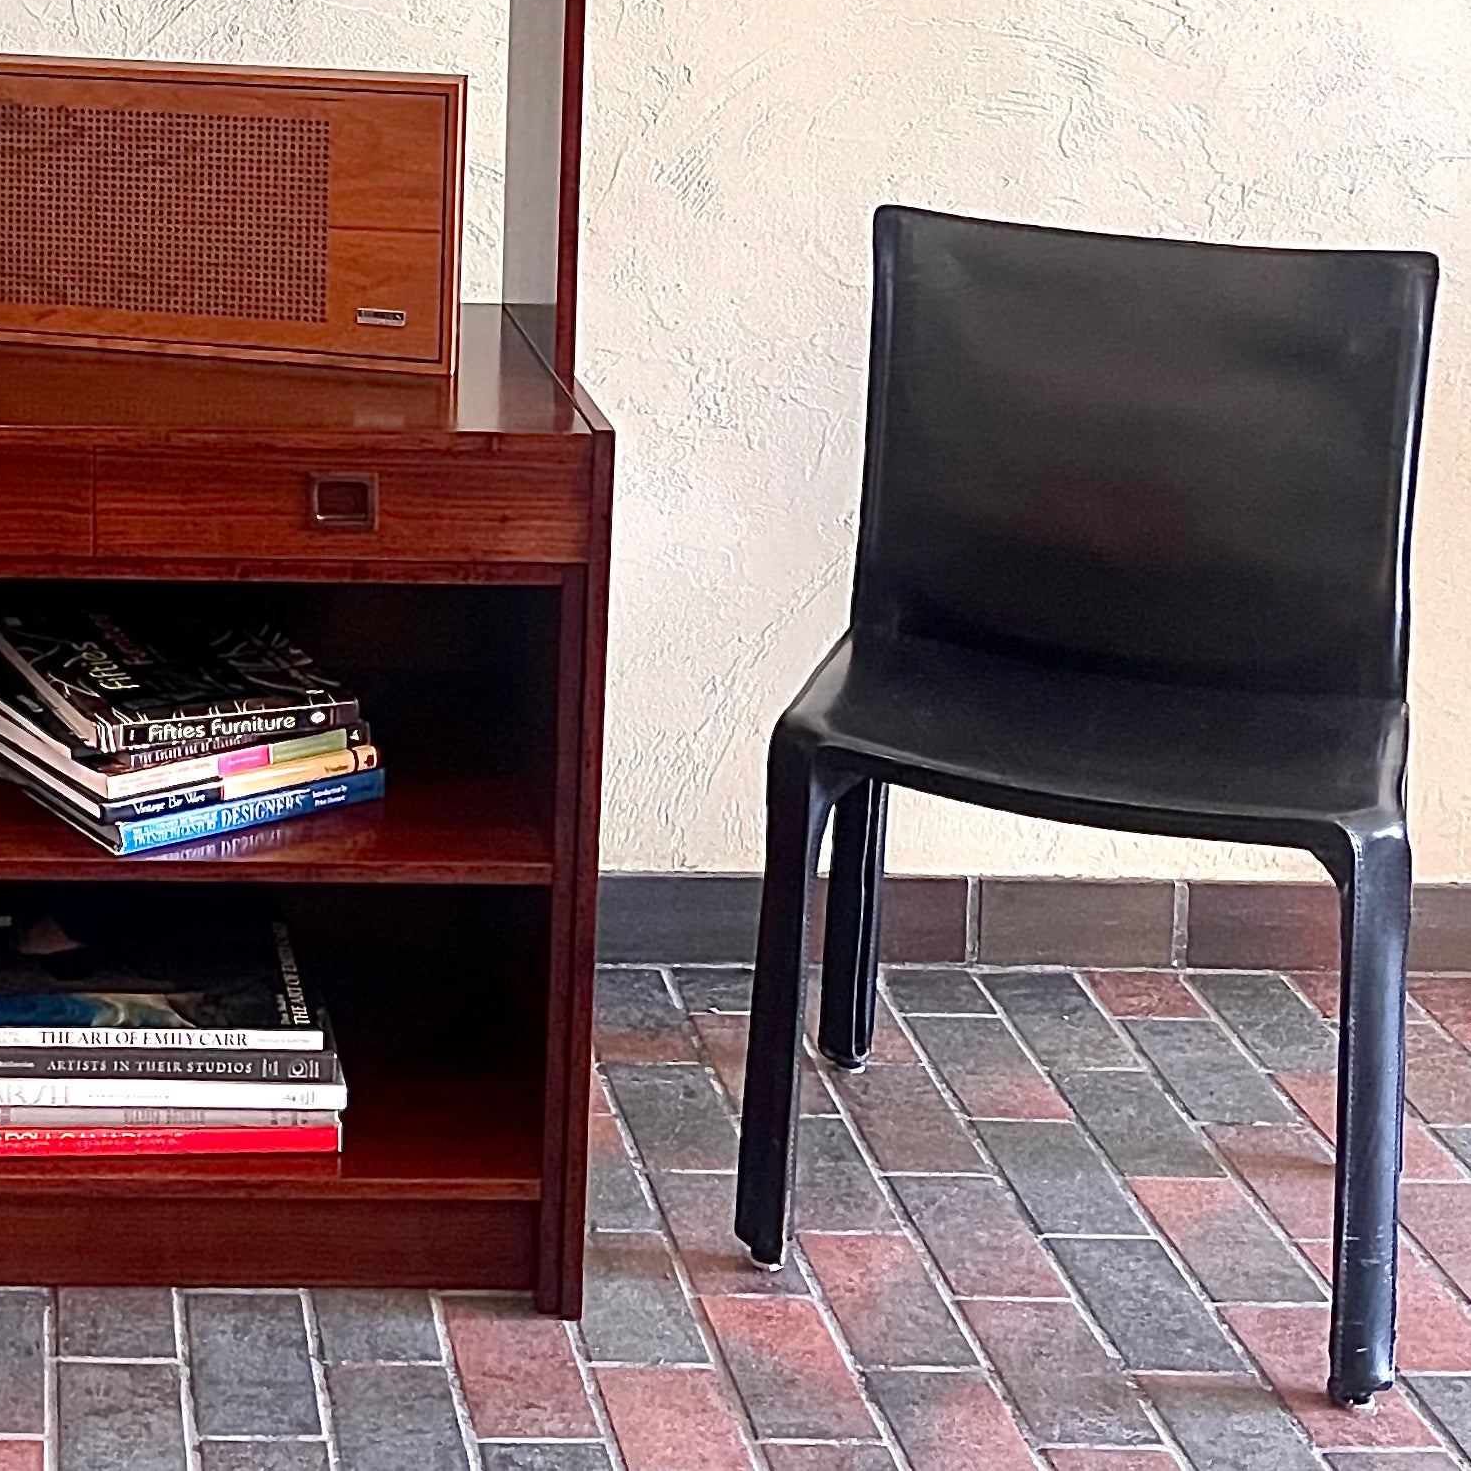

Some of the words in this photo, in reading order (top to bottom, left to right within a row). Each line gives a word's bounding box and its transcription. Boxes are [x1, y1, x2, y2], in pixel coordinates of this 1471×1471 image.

[148, 723, 206, 743] Fifties
[211, 715, 296, 736] Furniture
[220, 793, 303, 828] DESIGNERS
[39, 1031, 74, 1044] THE
[79, 1031, 110, 1045] ART
[115, 1031, 140, 1045] OF
[143, 1032, 196, 1045] EMILY
[199, 1032, 248, 1046] CARR
[47, 1060, 107, 1072] ARTISTS
[113, 1060, 130, 1072] IN
[135, 1061, 182, 1072] THEIR
[186, 1061, 253, 1074] STUDIOS
